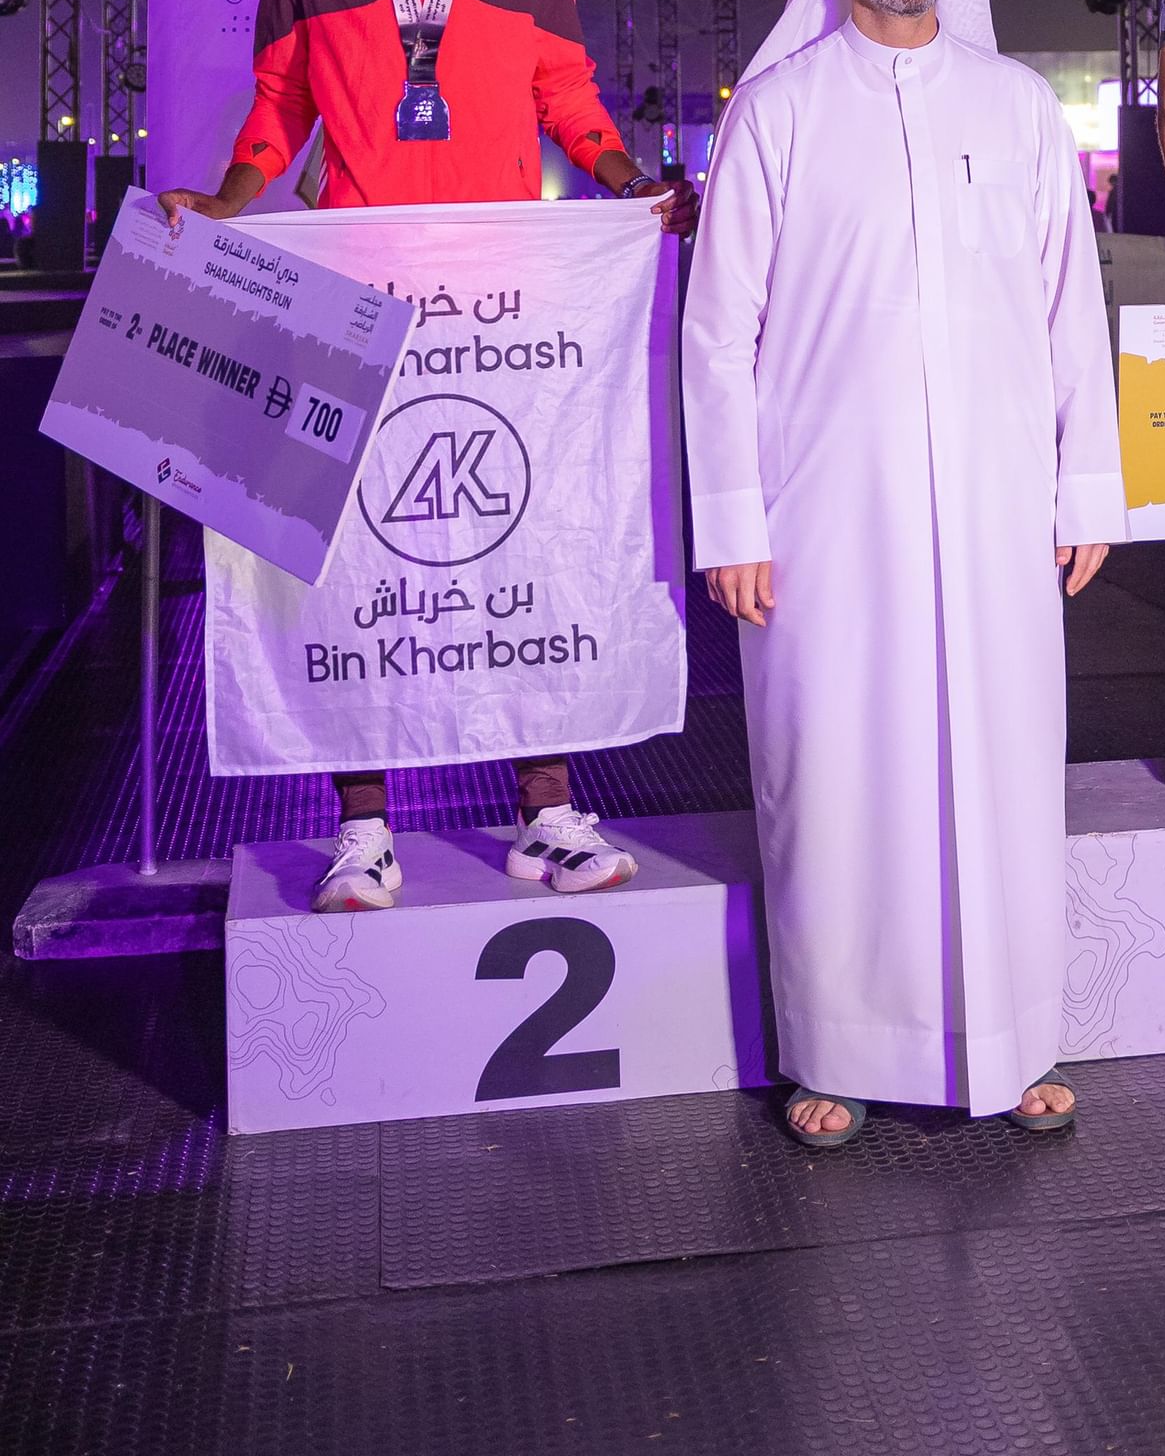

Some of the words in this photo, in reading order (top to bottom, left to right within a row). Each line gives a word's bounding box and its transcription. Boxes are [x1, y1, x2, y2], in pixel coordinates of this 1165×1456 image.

[213, 234, 252, 262] الشارقة
[250, 253, 282, 274] أضواء
[204, 261, 244, 289] SHARJAH
[241, 278, 273, 302] LIGHTS
[271, 291, 293, 310] RUN
[276, 268, 299, 286] جري
[473, 289, 521, 324] بن
[146, 323, 199, 368] PLACE
[196, 346, 262, 399] WINNER
[399, 331, 583, 377] harbash
[300, 397, 344, 443] 700
[1150, 412, 1162, 420] PAY
[353, 577, 475, 629] خرباش
[485, 580, 534, 619] بن
[304, 643, 366, 683] Bin
[377, 624, 599, 679] Kharbash
[474, 916, 621, 1103] 2
